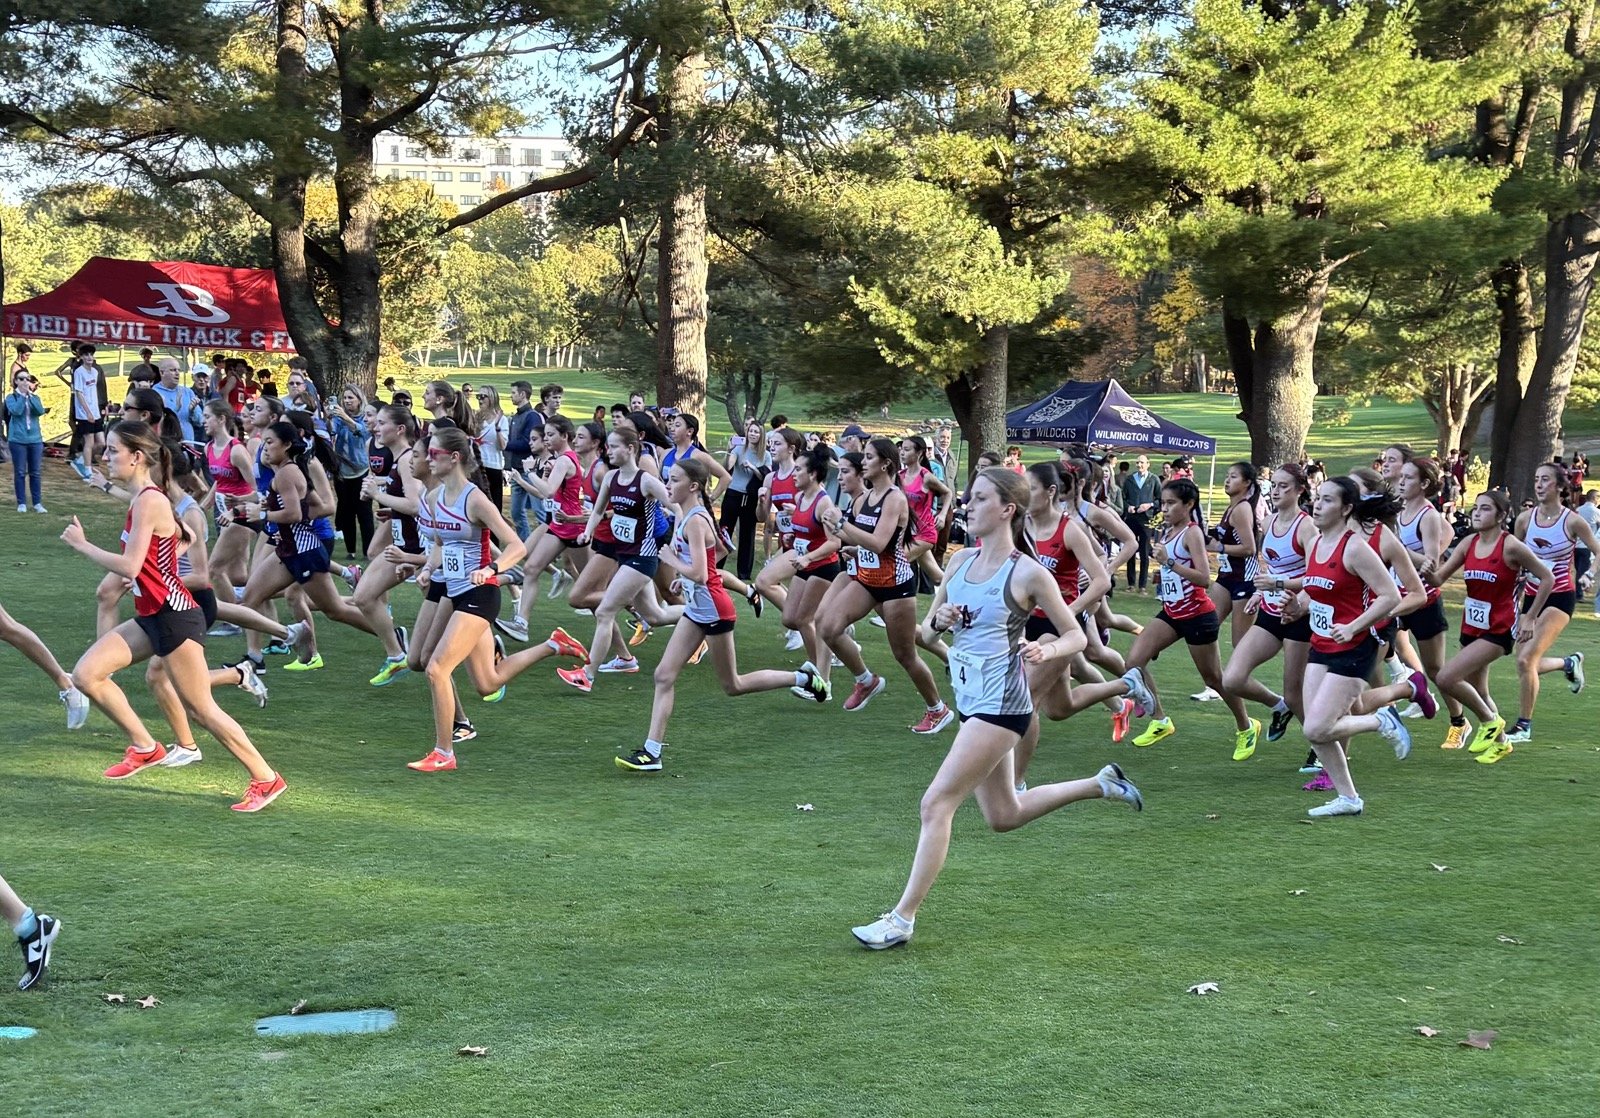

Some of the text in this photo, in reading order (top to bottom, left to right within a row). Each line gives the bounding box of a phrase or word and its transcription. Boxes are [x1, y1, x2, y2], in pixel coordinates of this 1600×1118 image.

[22, 314, 69, 336] RED
[76, 318, 151, 341] DEVIL
[159, 324, 242, 347] TRACK
[251, 332, 266, 348] &
[1037, 427, 1076, 439] WILDCATS
[1095, 430, 1210, 450] WILMINGTON WILDCATS
[614, 524, 631, 539] 276
[859, 551, 875, 563] 248
[1312, 612, 1328, 631] 128
[1468, 607, 1485, 624] 123
[959, 665, 967, 685] 4
